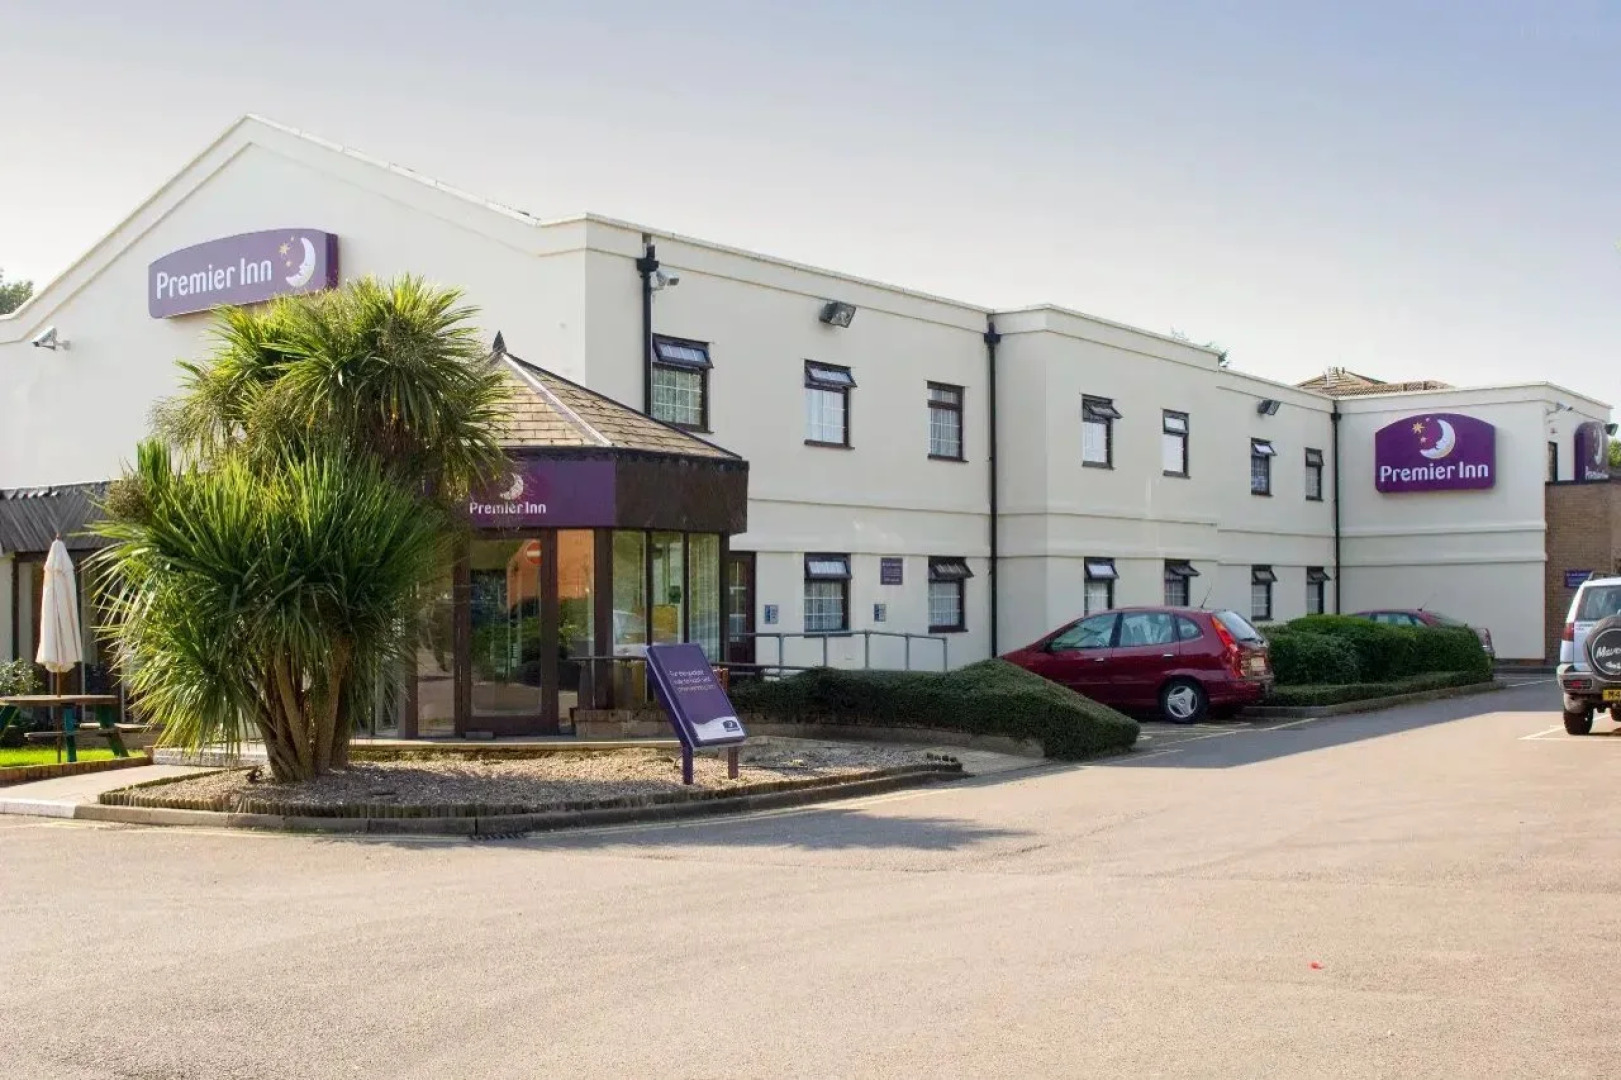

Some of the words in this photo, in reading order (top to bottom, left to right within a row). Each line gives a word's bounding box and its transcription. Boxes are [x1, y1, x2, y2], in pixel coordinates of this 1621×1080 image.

[156, 264, 235, 299] Premier
[240, 257, 272, 286] Inn
[1380, 462, 1455, 482] Premier
[1459, 461, 1489, 479] Inn
[469, 502, 523, 514] Premier
[525, 501, 547, 514] Inn
